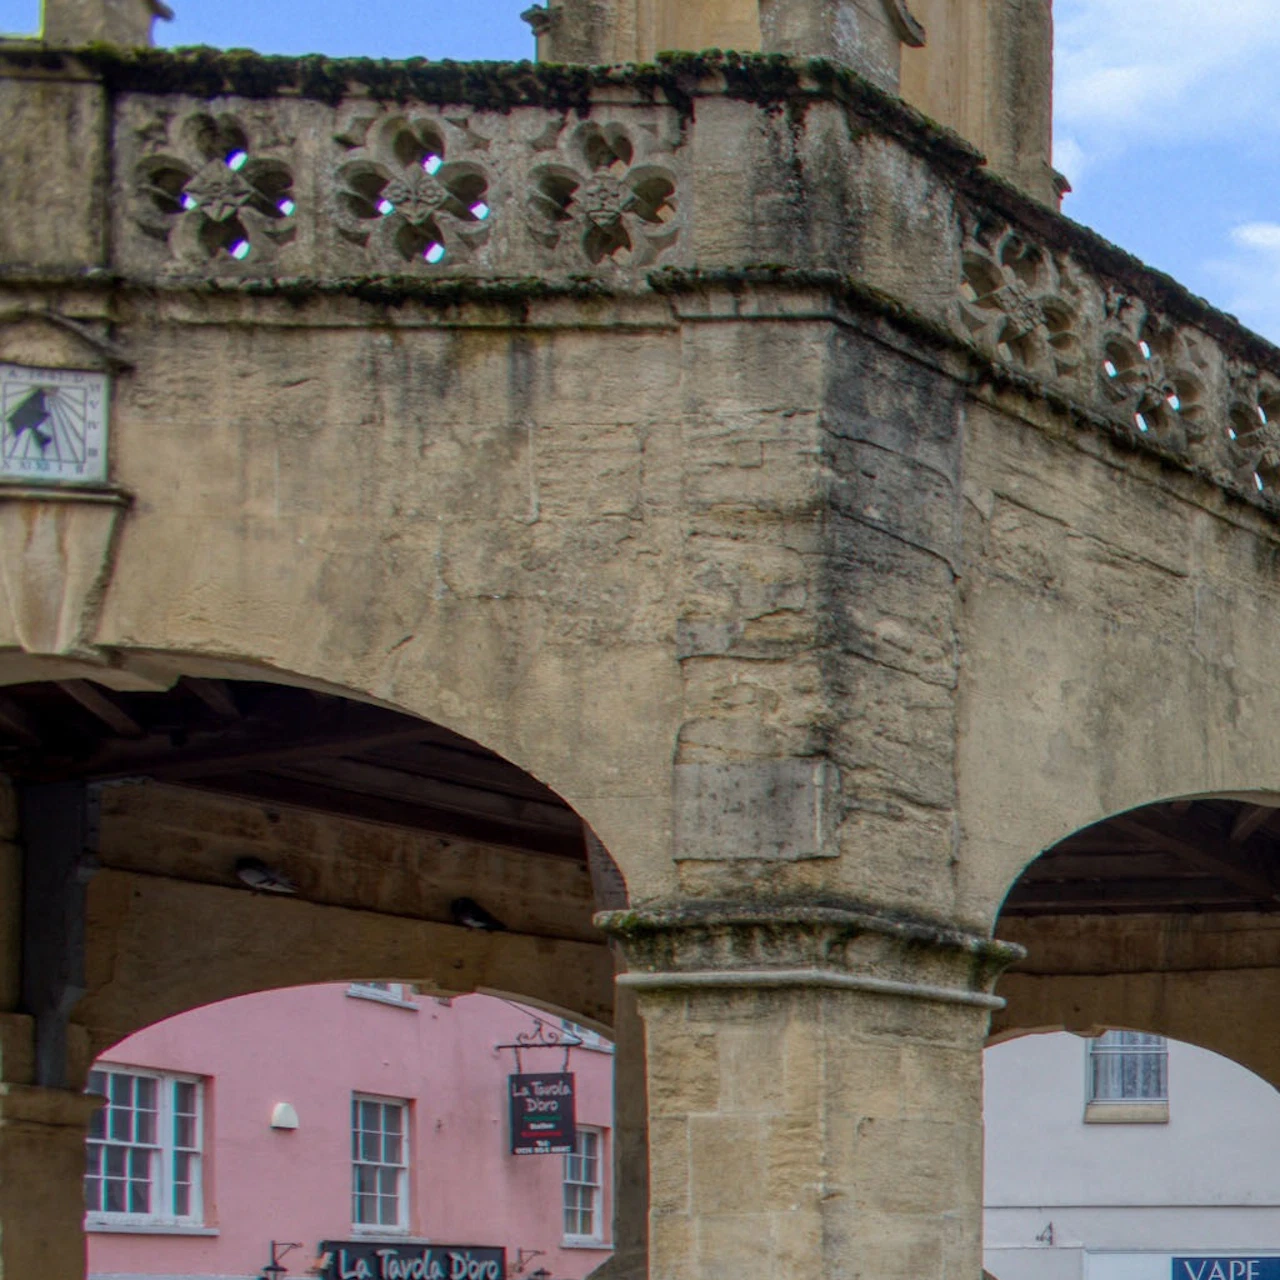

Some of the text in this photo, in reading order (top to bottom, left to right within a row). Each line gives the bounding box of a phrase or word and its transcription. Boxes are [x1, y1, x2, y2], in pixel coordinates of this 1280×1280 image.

[512, 1080, 573, 1097] La Tavola
[525, 1098, 559, 1113] D'oro
[338, 1249, 500, 1280] La Tavola D'oro
